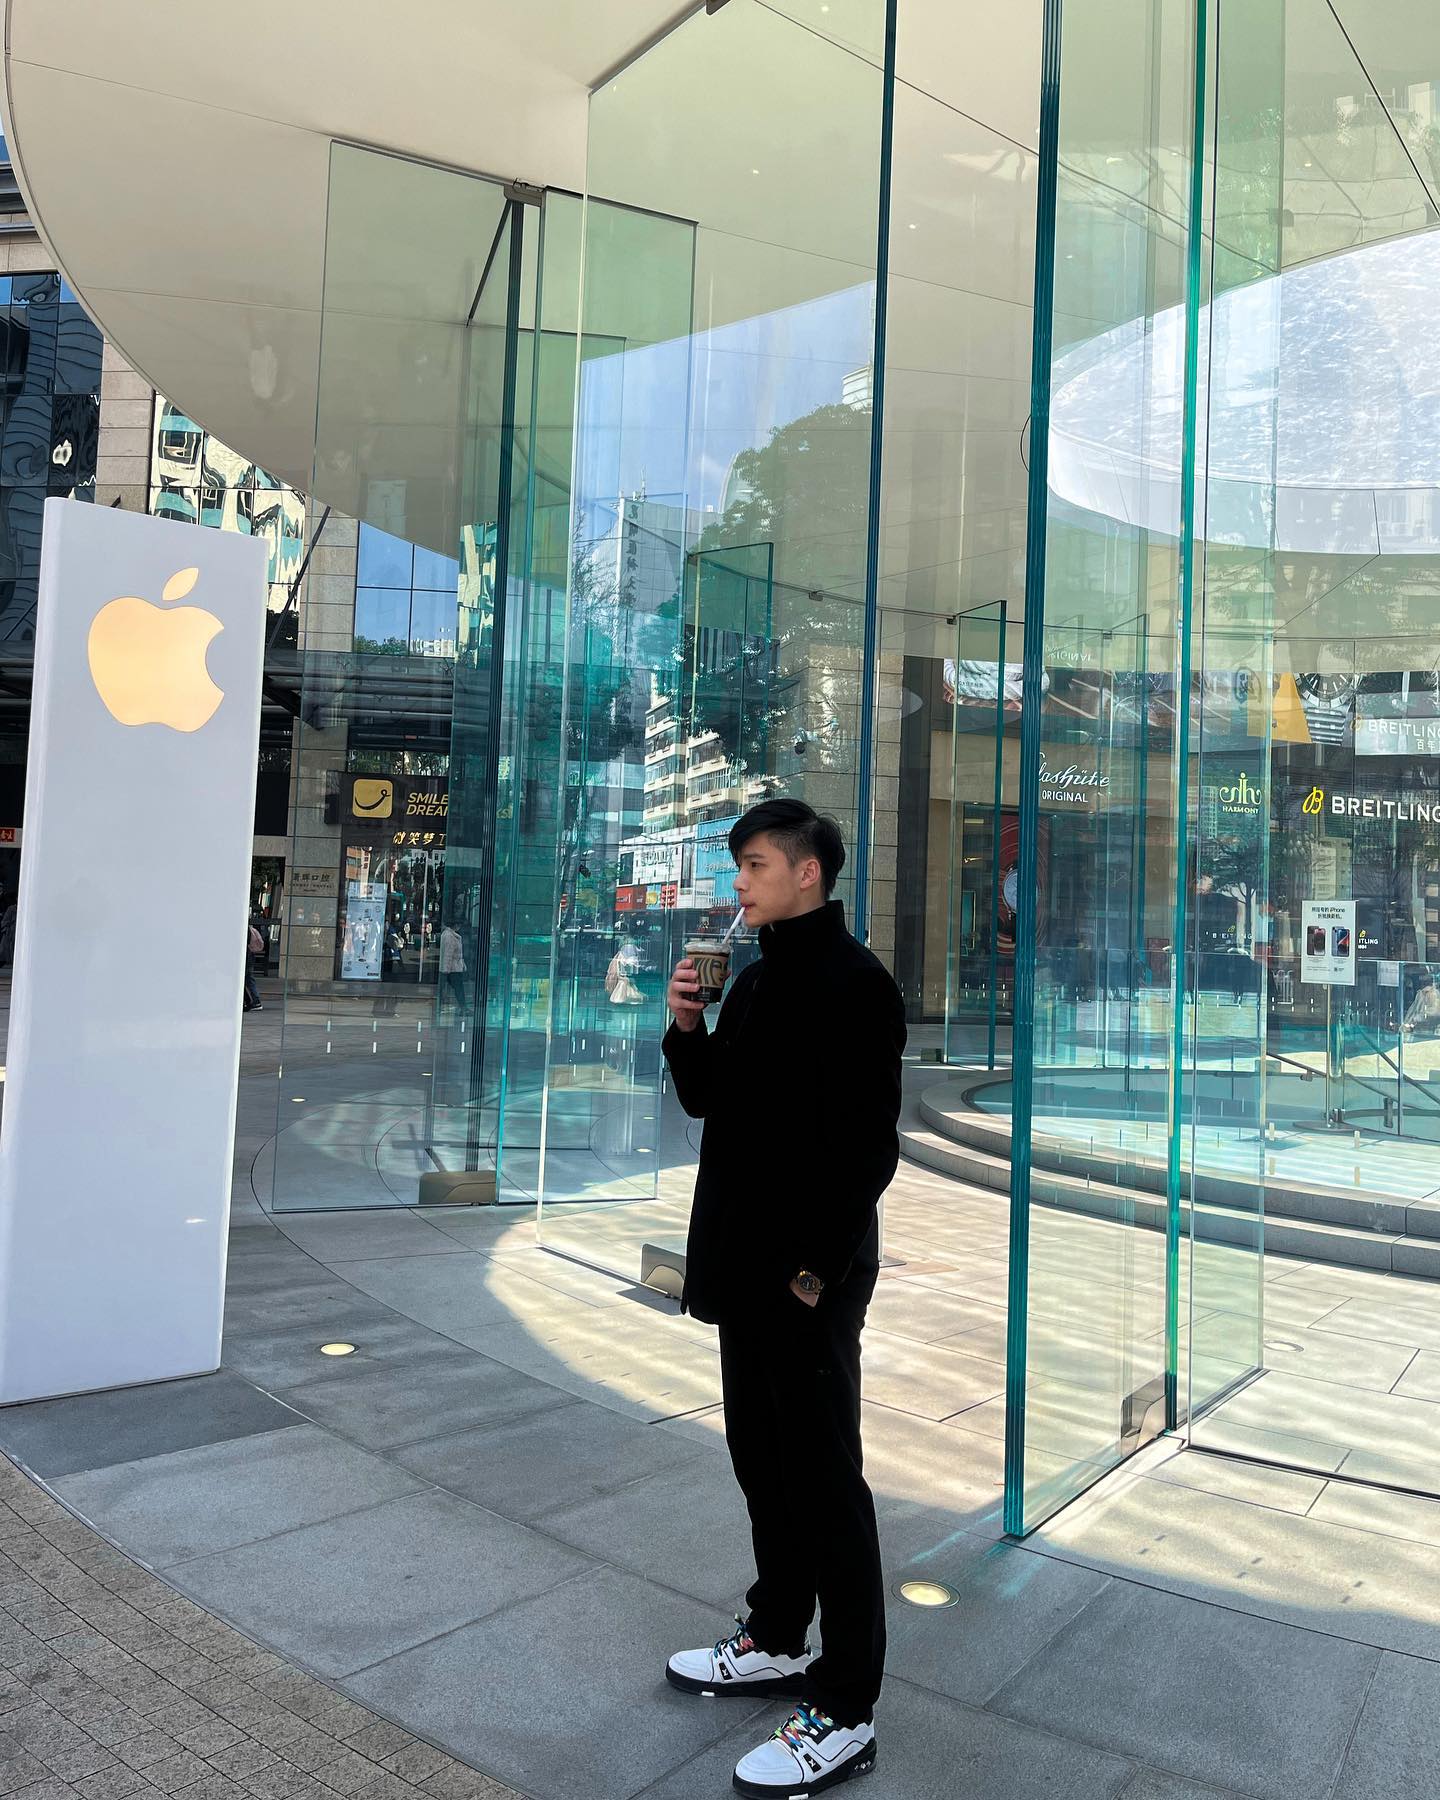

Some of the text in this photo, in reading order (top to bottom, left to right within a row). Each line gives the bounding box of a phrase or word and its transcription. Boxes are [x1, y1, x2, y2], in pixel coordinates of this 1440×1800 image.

[1368, 719, 1440, 738] BREITLIN
[1416, 739, 1440, 751] 百年
[407, 792, 448, 804] SMILE
[1042, 790, 1088, 802] ORIGINAL
